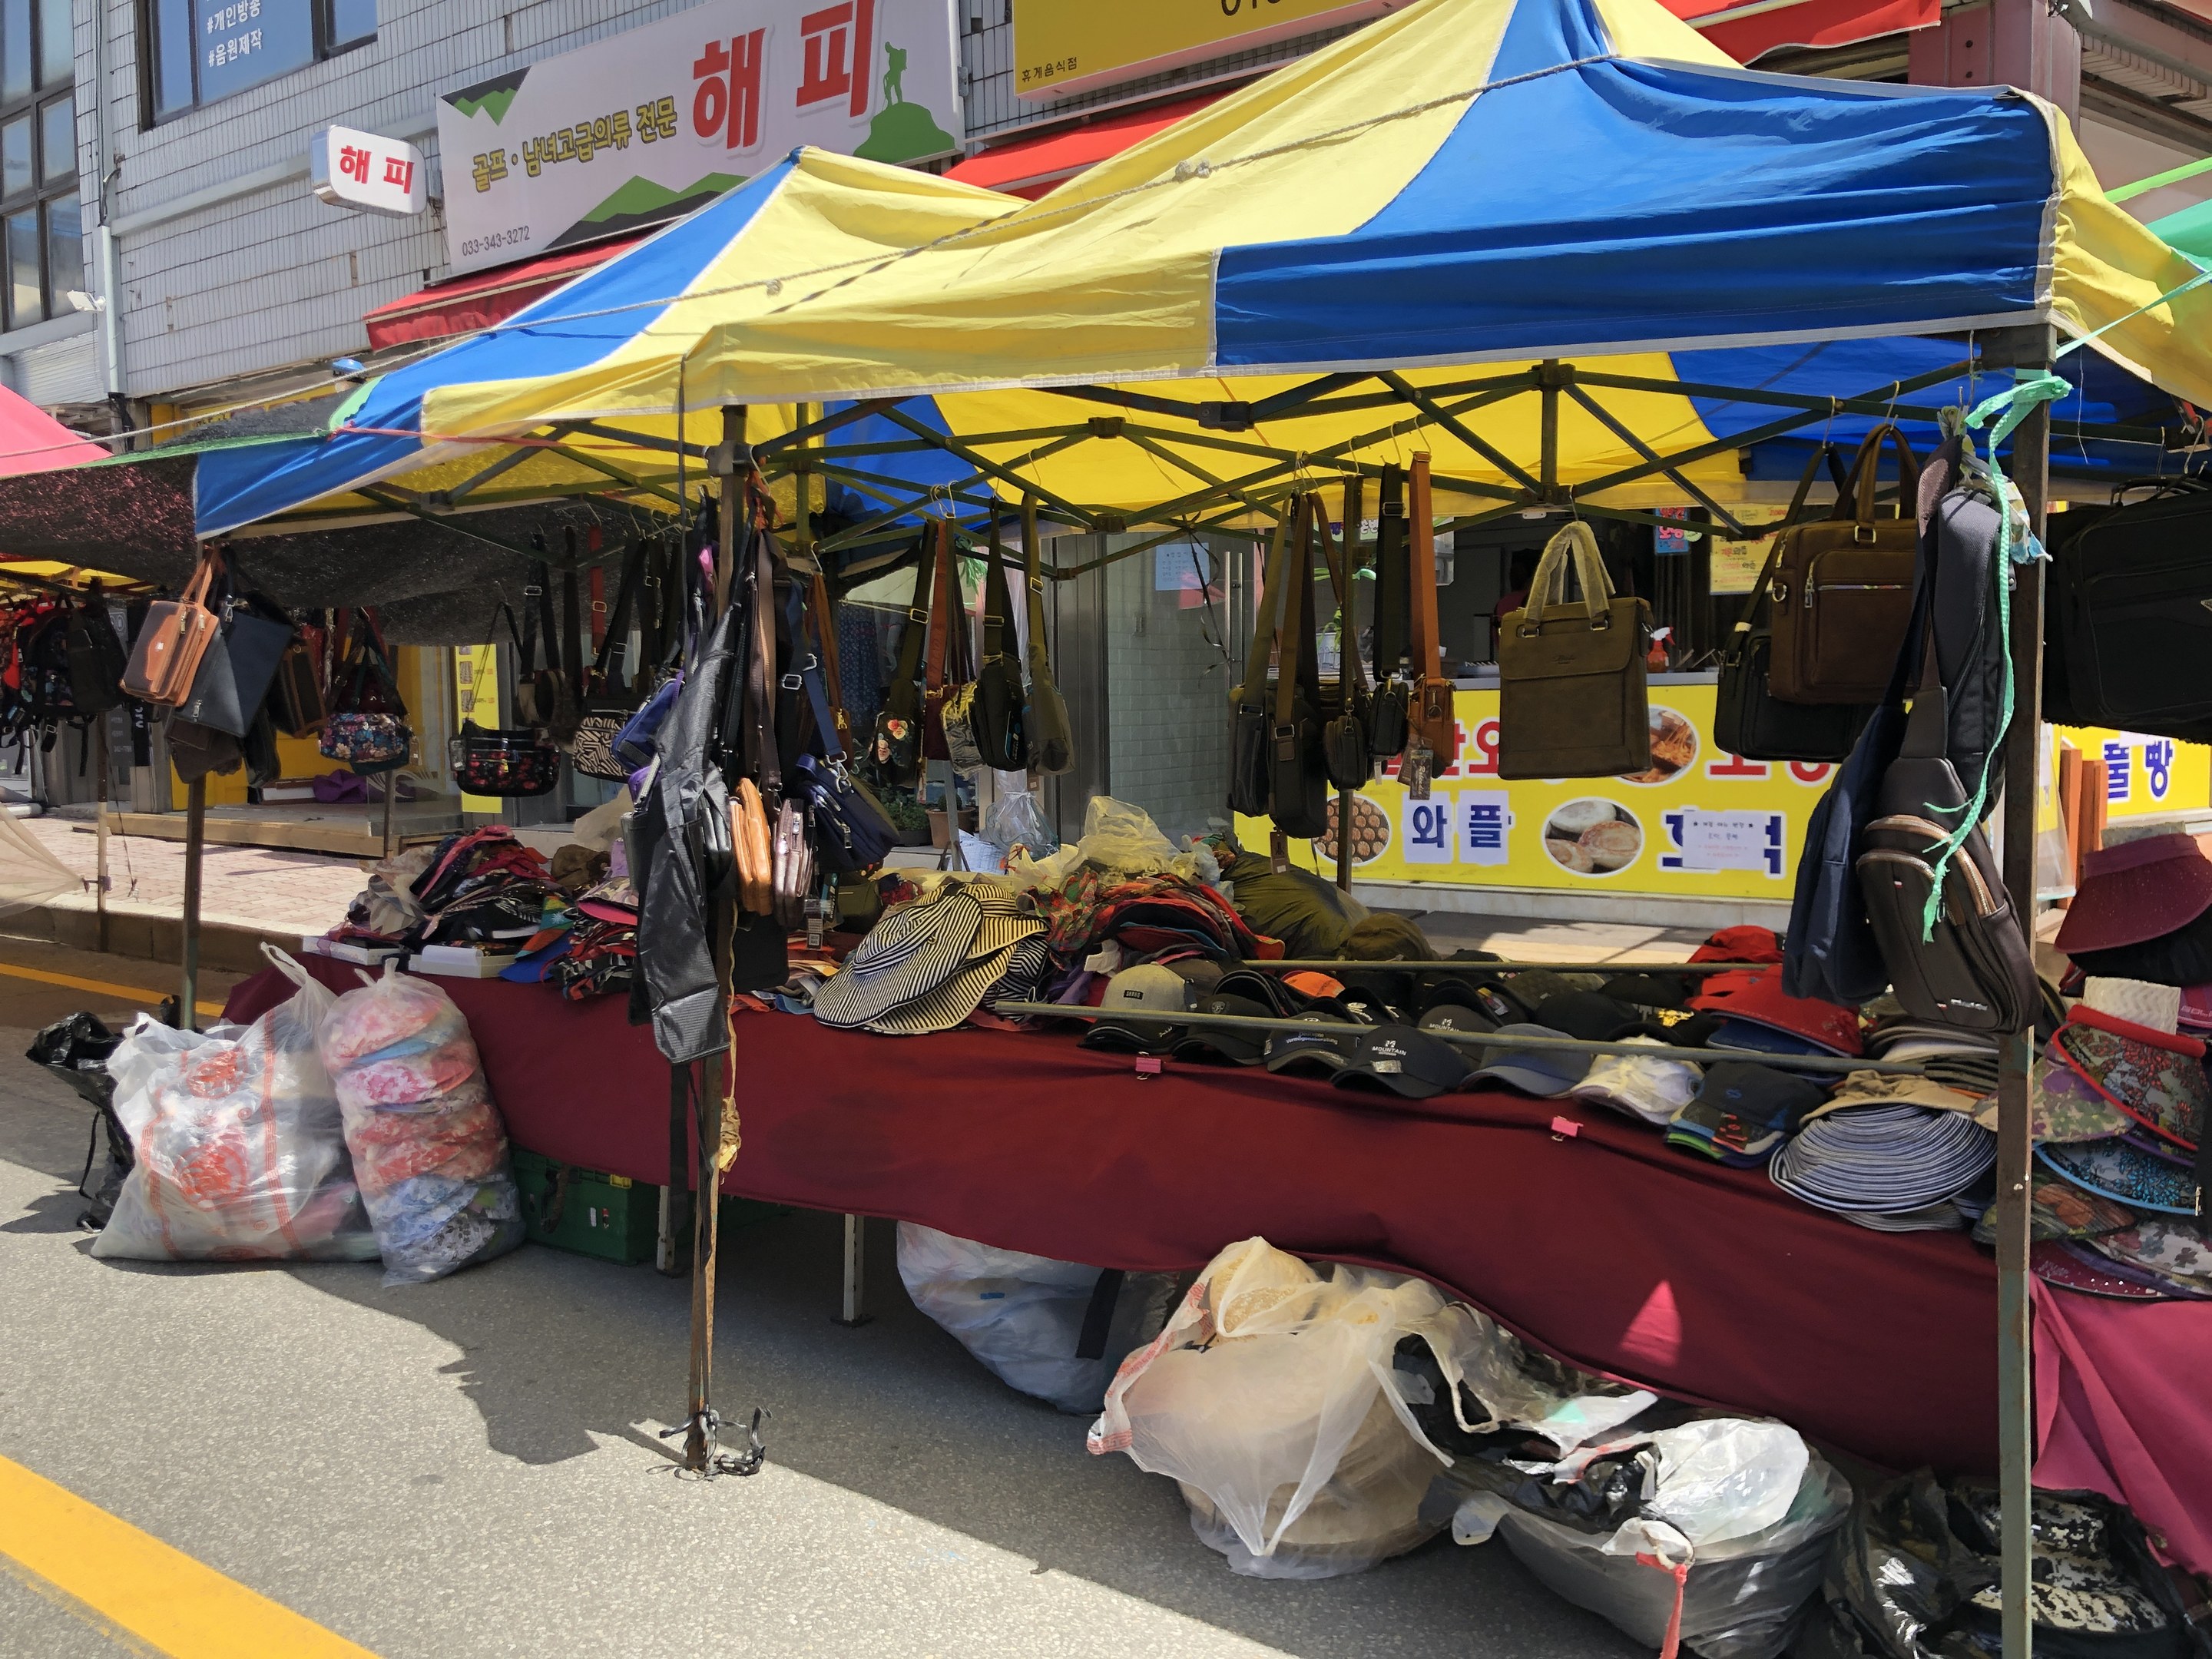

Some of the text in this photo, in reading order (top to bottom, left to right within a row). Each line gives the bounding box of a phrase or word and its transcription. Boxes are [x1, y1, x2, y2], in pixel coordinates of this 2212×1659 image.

[208, 28, 262, 68] #음원제작
[1022, 57, 1078, 83] 휴게음식점
[472, 95, 678, 193] 골프 남녀고급의류 전문
[462, 225, 531, 257] 033-343-3272
[1371, 1045, 1408, 1057] MOUNTAIN
